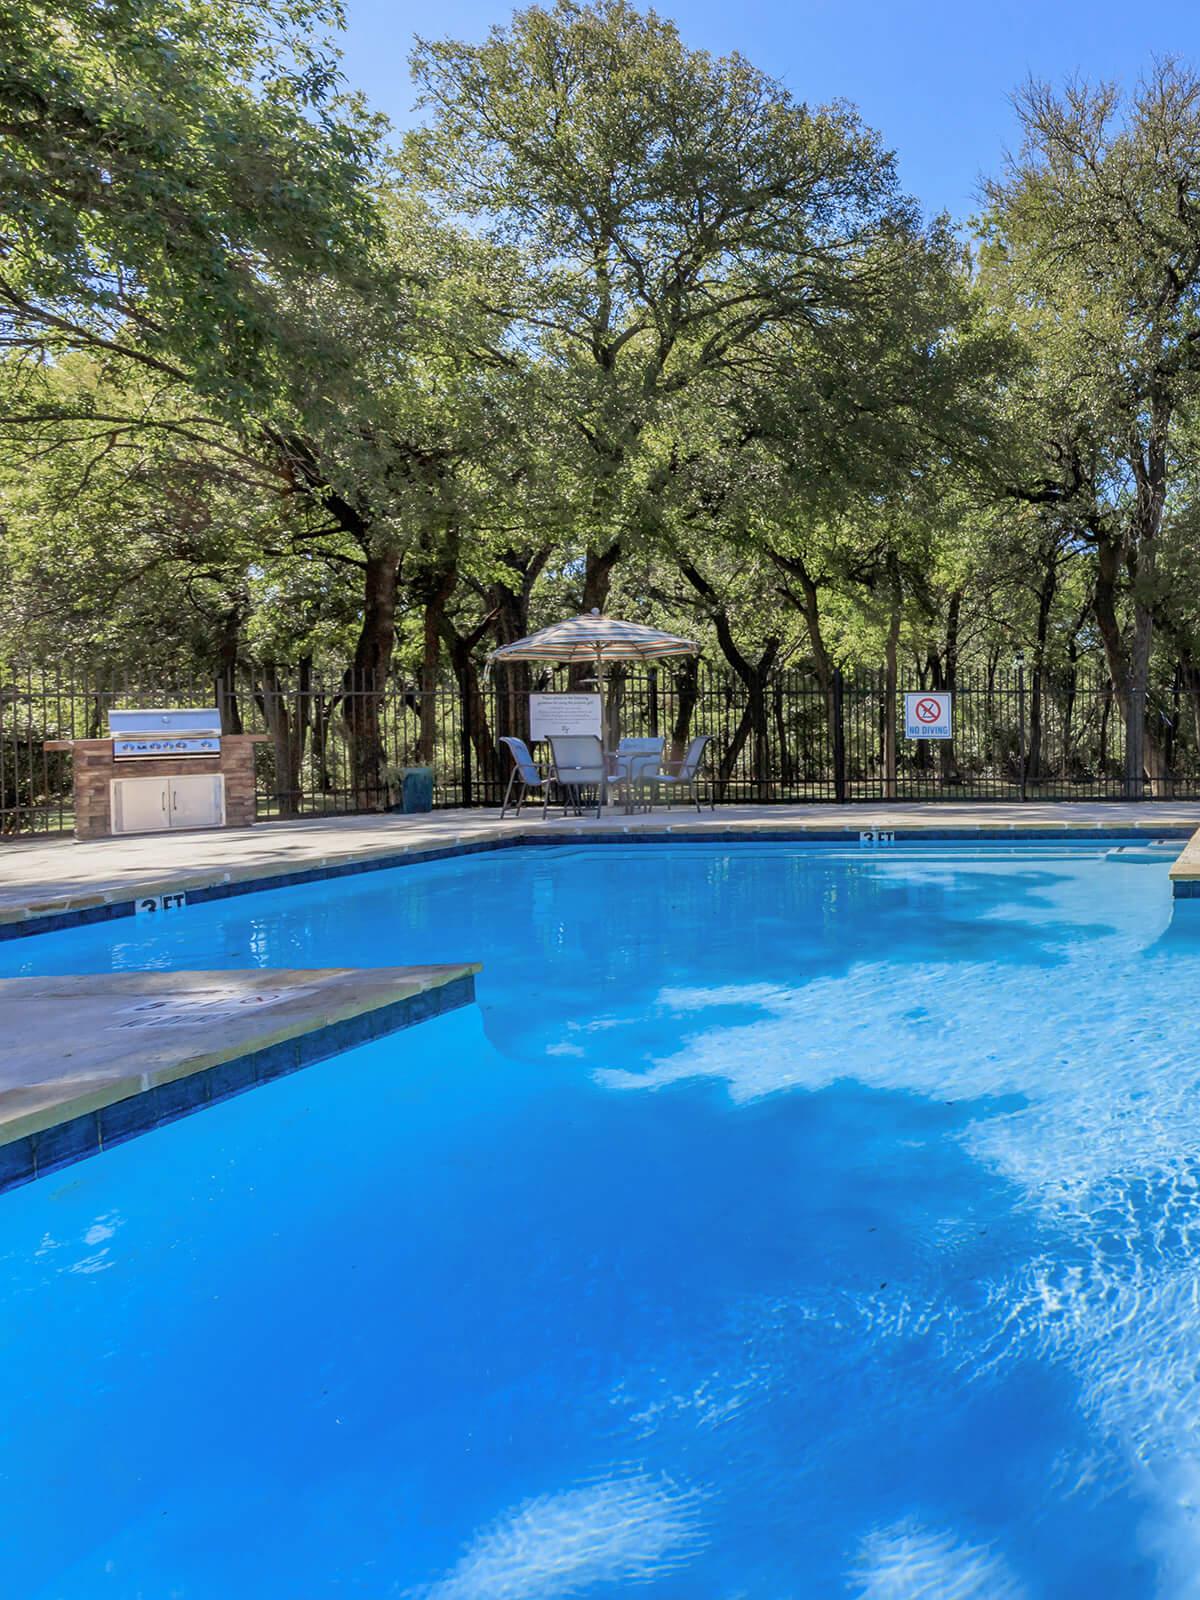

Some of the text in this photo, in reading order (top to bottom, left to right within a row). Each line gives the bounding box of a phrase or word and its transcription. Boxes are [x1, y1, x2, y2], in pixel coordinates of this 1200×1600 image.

[909, 726, 948, 735] NO DIVING
[163, 894, 185, 910] FT
